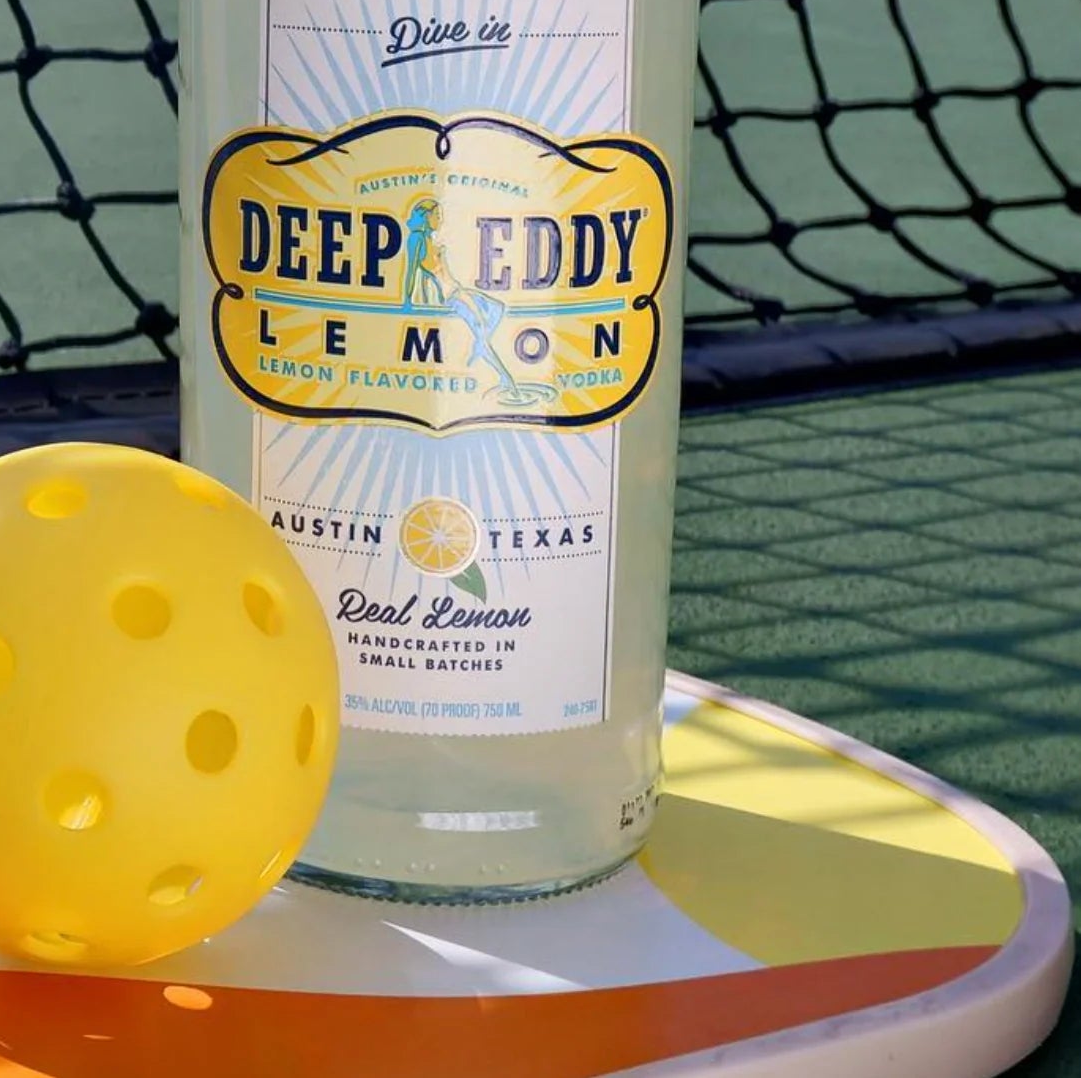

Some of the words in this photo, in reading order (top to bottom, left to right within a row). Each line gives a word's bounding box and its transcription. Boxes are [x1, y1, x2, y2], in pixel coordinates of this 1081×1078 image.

[385, 16, 470, 53] Dive
[476, 14, 513, 42] in
[359, 172, 438, 195] AUSTIN'S
[447, 173, 529, 198] ORIGINAL
[239, 198, 403, 288] DEEP
[475, 208, 642, 291] EDDY
[259, 309, 621, 364] LEMON
[259, 355, 334, 382] LEMON
[350, 370, 476, 393] FLAVORED
[557, 370, 624, 389] VODKA
[271, 510, 382, 544] AUSTIN
[489, 524, 594, 550] TEXAS
[336, 588, 418, 626] Real
[422, 595, 532, 630] Lemon
[347, 631, 486, 653] HANDCRAFTED
[496, 640, 516, 652] IN
[359, 652, 417, 670] SMALL
[425, 658, 504, 671] BATCHES
[344, 693, 369, 711] 35%
[371, 697, 418, 716] ALC/VOL
[421, 701, 439, 720] (70
[441, 702, 480, 720] PROOF)
[483, 702, 504, 719] 750
[505, 701, 524, 718] ML
